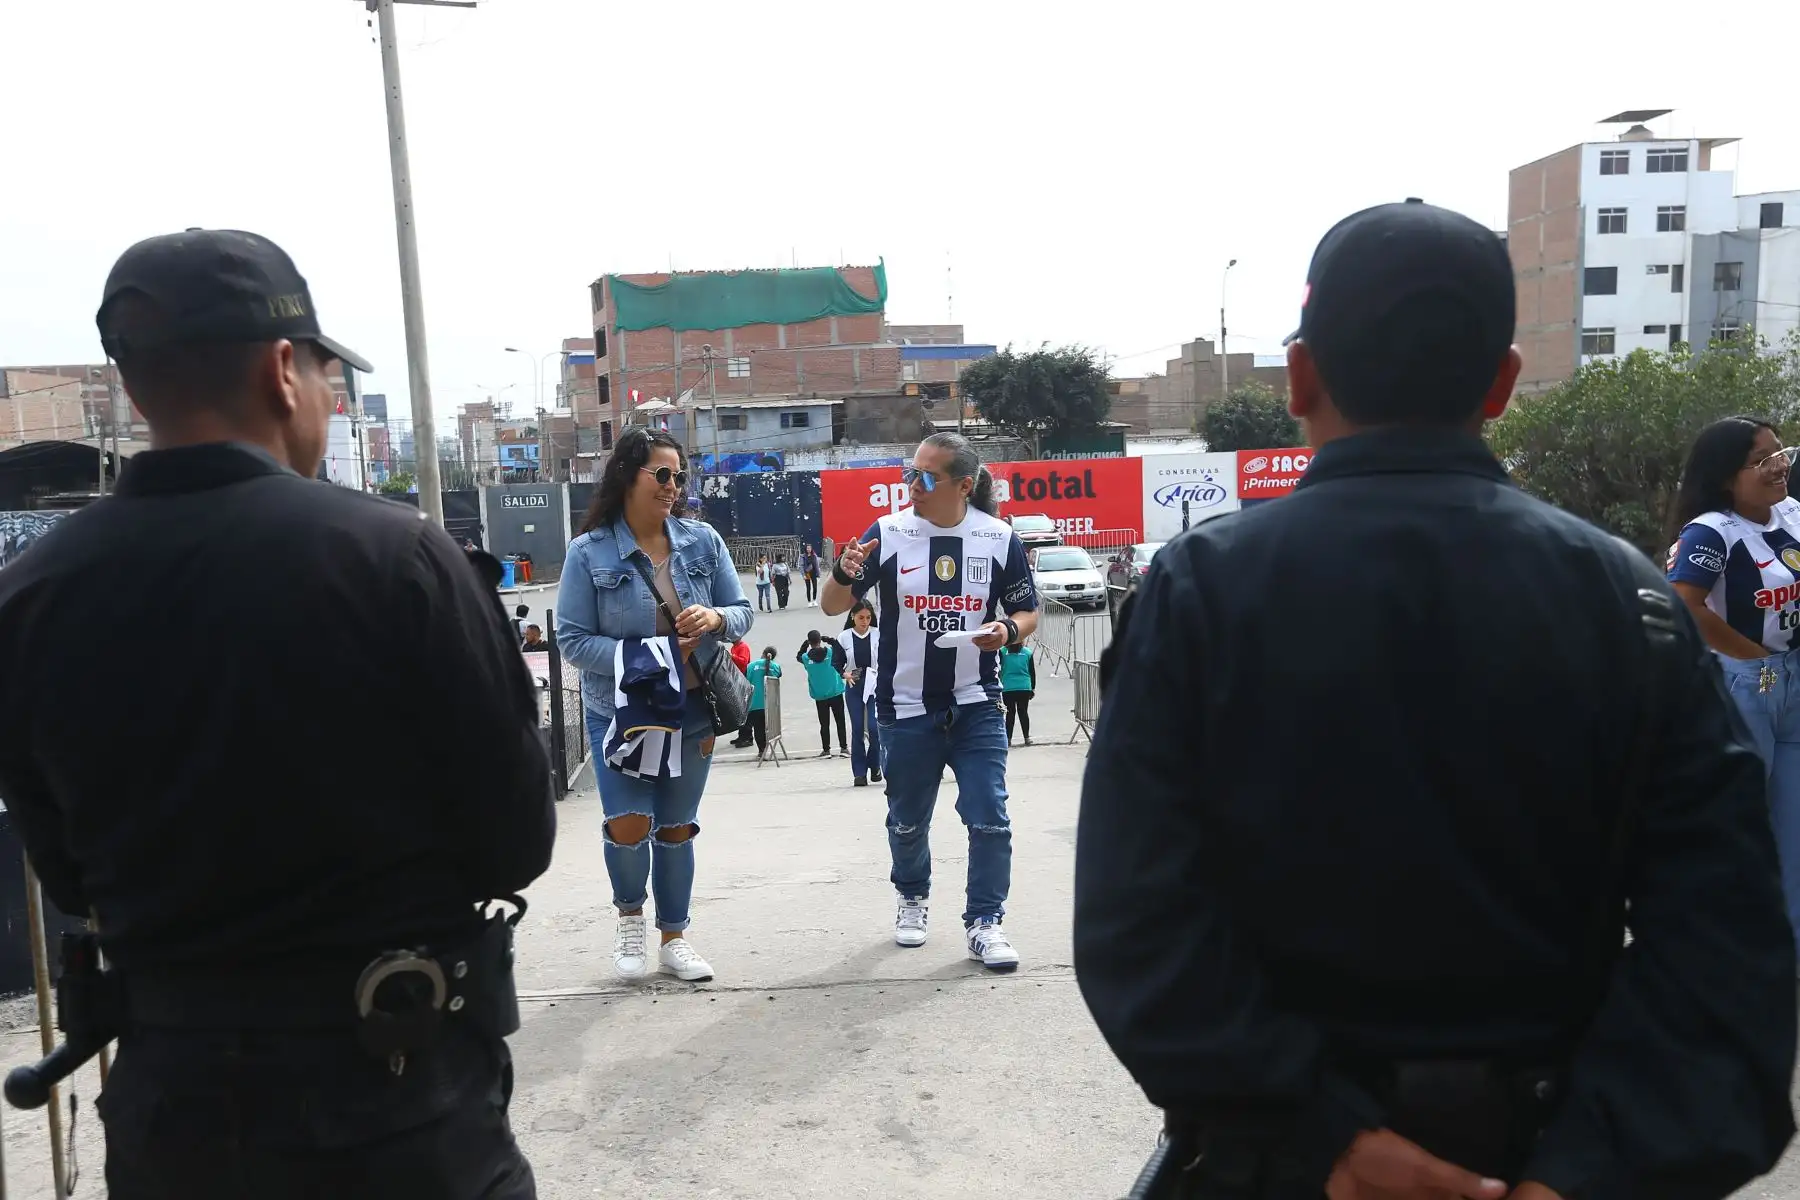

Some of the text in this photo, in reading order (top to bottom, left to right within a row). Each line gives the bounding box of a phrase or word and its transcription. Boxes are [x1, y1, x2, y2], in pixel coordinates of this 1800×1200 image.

[1158, 467, 1219, 476] CONSERVAS
[1272, 455, 1315, 472] SAC
[504, 496, 545, 507] SALIDA
[1161, 484, 1217, 507] Arica
[888, 525, 920, 534] GLORY
[971, 530, 1003, 538] GLORY
[1694, 555, 1720, 569] Arica
[904, 594, 983, 614] apuesta
[1754, 581, 1800, 611] apu
[917, 614, 967, 632] total
[1778, 608, 1800, 631] to
